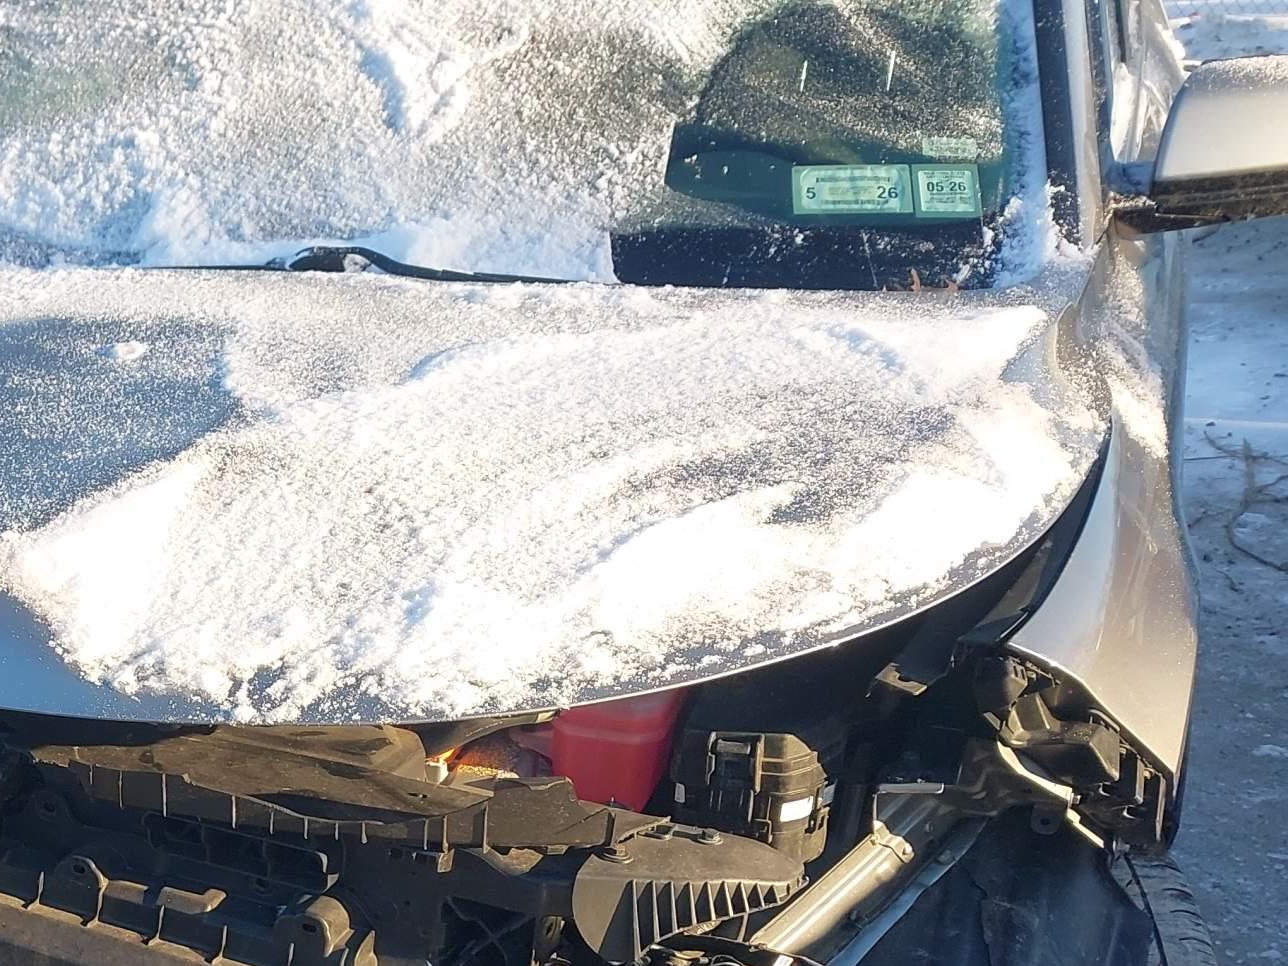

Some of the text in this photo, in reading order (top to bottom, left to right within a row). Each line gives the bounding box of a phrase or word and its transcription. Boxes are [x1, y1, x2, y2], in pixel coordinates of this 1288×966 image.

[806, 187, 817, 200] 5
[876, 185, 899, 199] 26
[926, 181, 967, 192] 05 26
